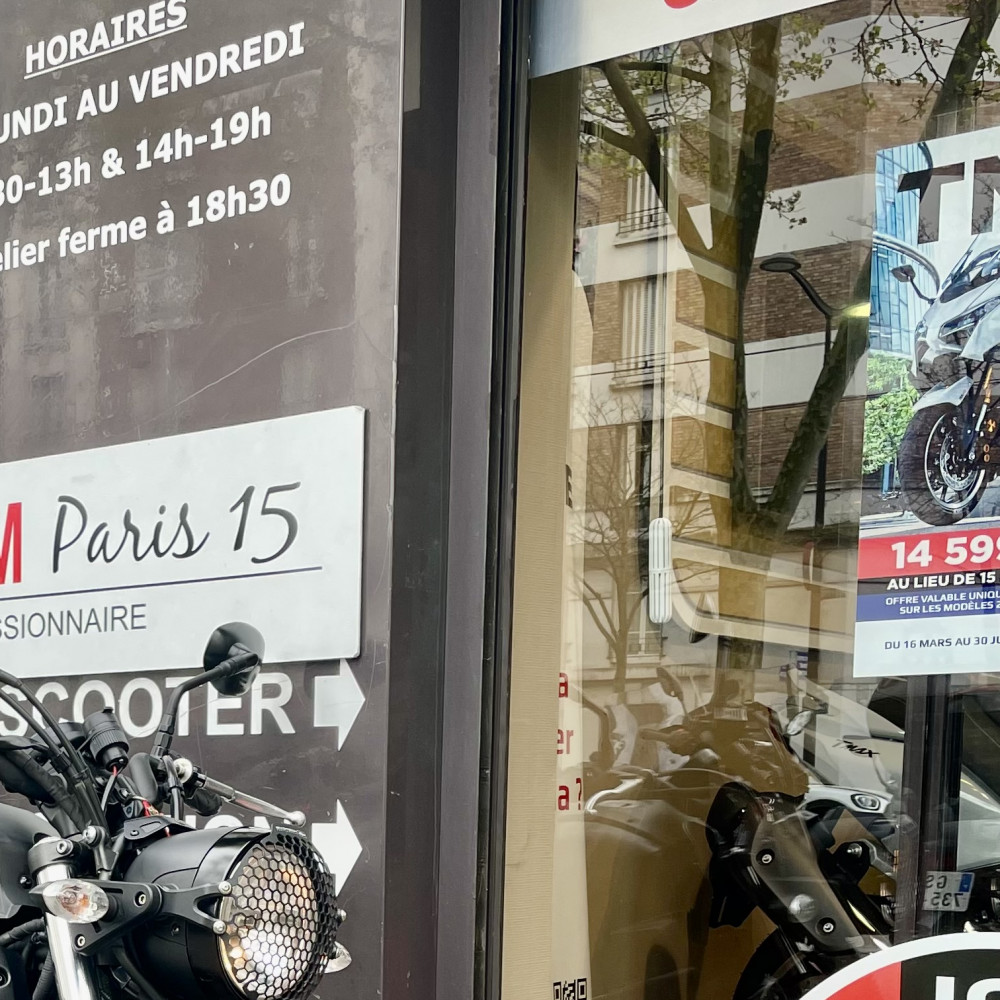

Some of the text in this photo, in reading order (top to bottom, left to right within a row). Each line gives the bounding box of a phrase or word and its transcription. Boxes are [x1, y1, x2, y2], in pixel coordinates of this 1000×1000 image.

[25, 0, 187, 75] HORAIRES
[76, 80, 119, 121] AU
[129, 22, 306, 104] VENDREDI
[101, 147, 126, 179] &
[135, 106, 272, 170] 14h-19h
[58, 211, 148, 258] ferme
[156, 201, 176, 234] à
[186, 173, 292, 227] 18h30
[52, 495, 211, 574] Paris
[228, 481, 302, 564] 15
[890, 534, 1000, 570] 14 59
[885, 595, 919, 606] OFFRE
[921, 592, 967, 603] VALABLE
[886, 571, 997, 591] AU LIEU DE 15
[899, 604, 920, 615] SUR
[922, 603, 942, 613] LES
[943, 600, 994, 613] MODÈLES
[884, 641, 901, 650] DU
[904, 640, 917, 649] 16
[919, 638, 952, 649] MARS
[955, 637, 972, 647] AU
[974, 636, 988, 646] 30
